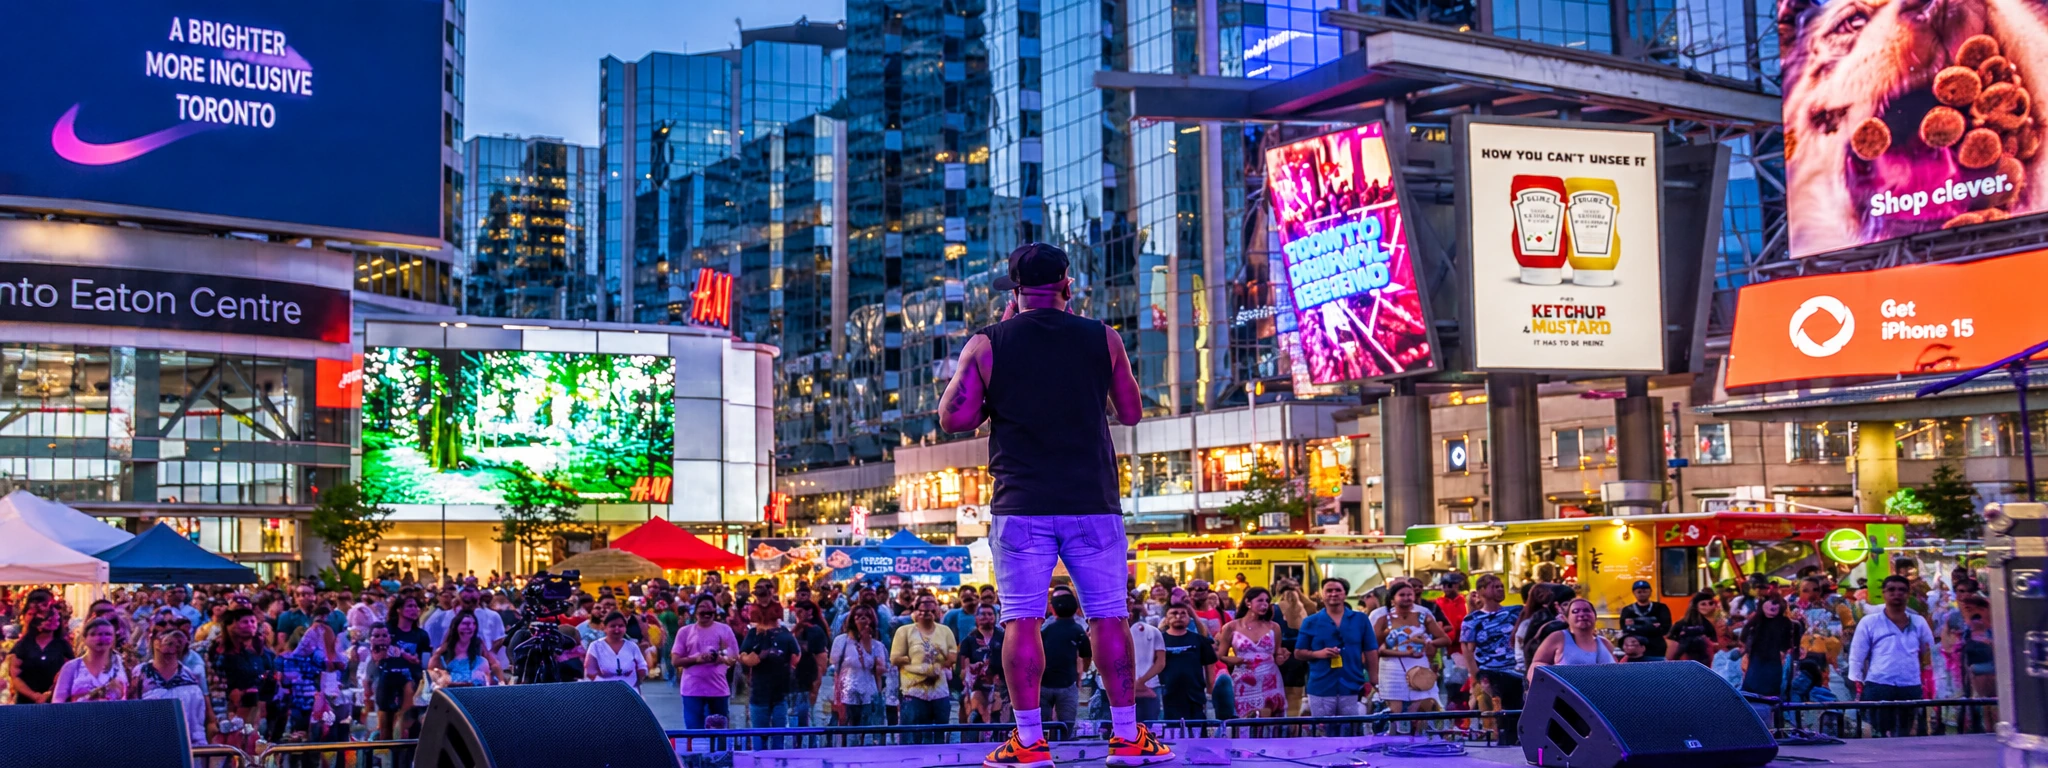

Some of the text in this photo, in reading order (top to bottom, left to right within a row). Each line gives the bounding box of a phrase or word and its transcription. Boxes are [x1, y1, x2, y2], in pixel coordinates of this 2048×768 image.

[169, 16, 286, 57] A BRIGHTER
[146, 50, 313, 96] MORE INCLUSIVE
[176, 93, 276, 129] TORONTO
[1516, 150, 1543, 161] YOU
[1547, 152, 1585, 163] CAN'T
[1590, 154, 1630, 166] UNSEE
[1870, 174, 2013, 216] Shop clever.
[0, 277, 302, 325] nto Eaton Centre
[1531, 304, 1606, 319] KETCHUP
[1880, 298, 1916, 318] Get
[1532, 319, 1612, 335] MUSTARD
[1881, 318, 1974, 340] iPhone 15
